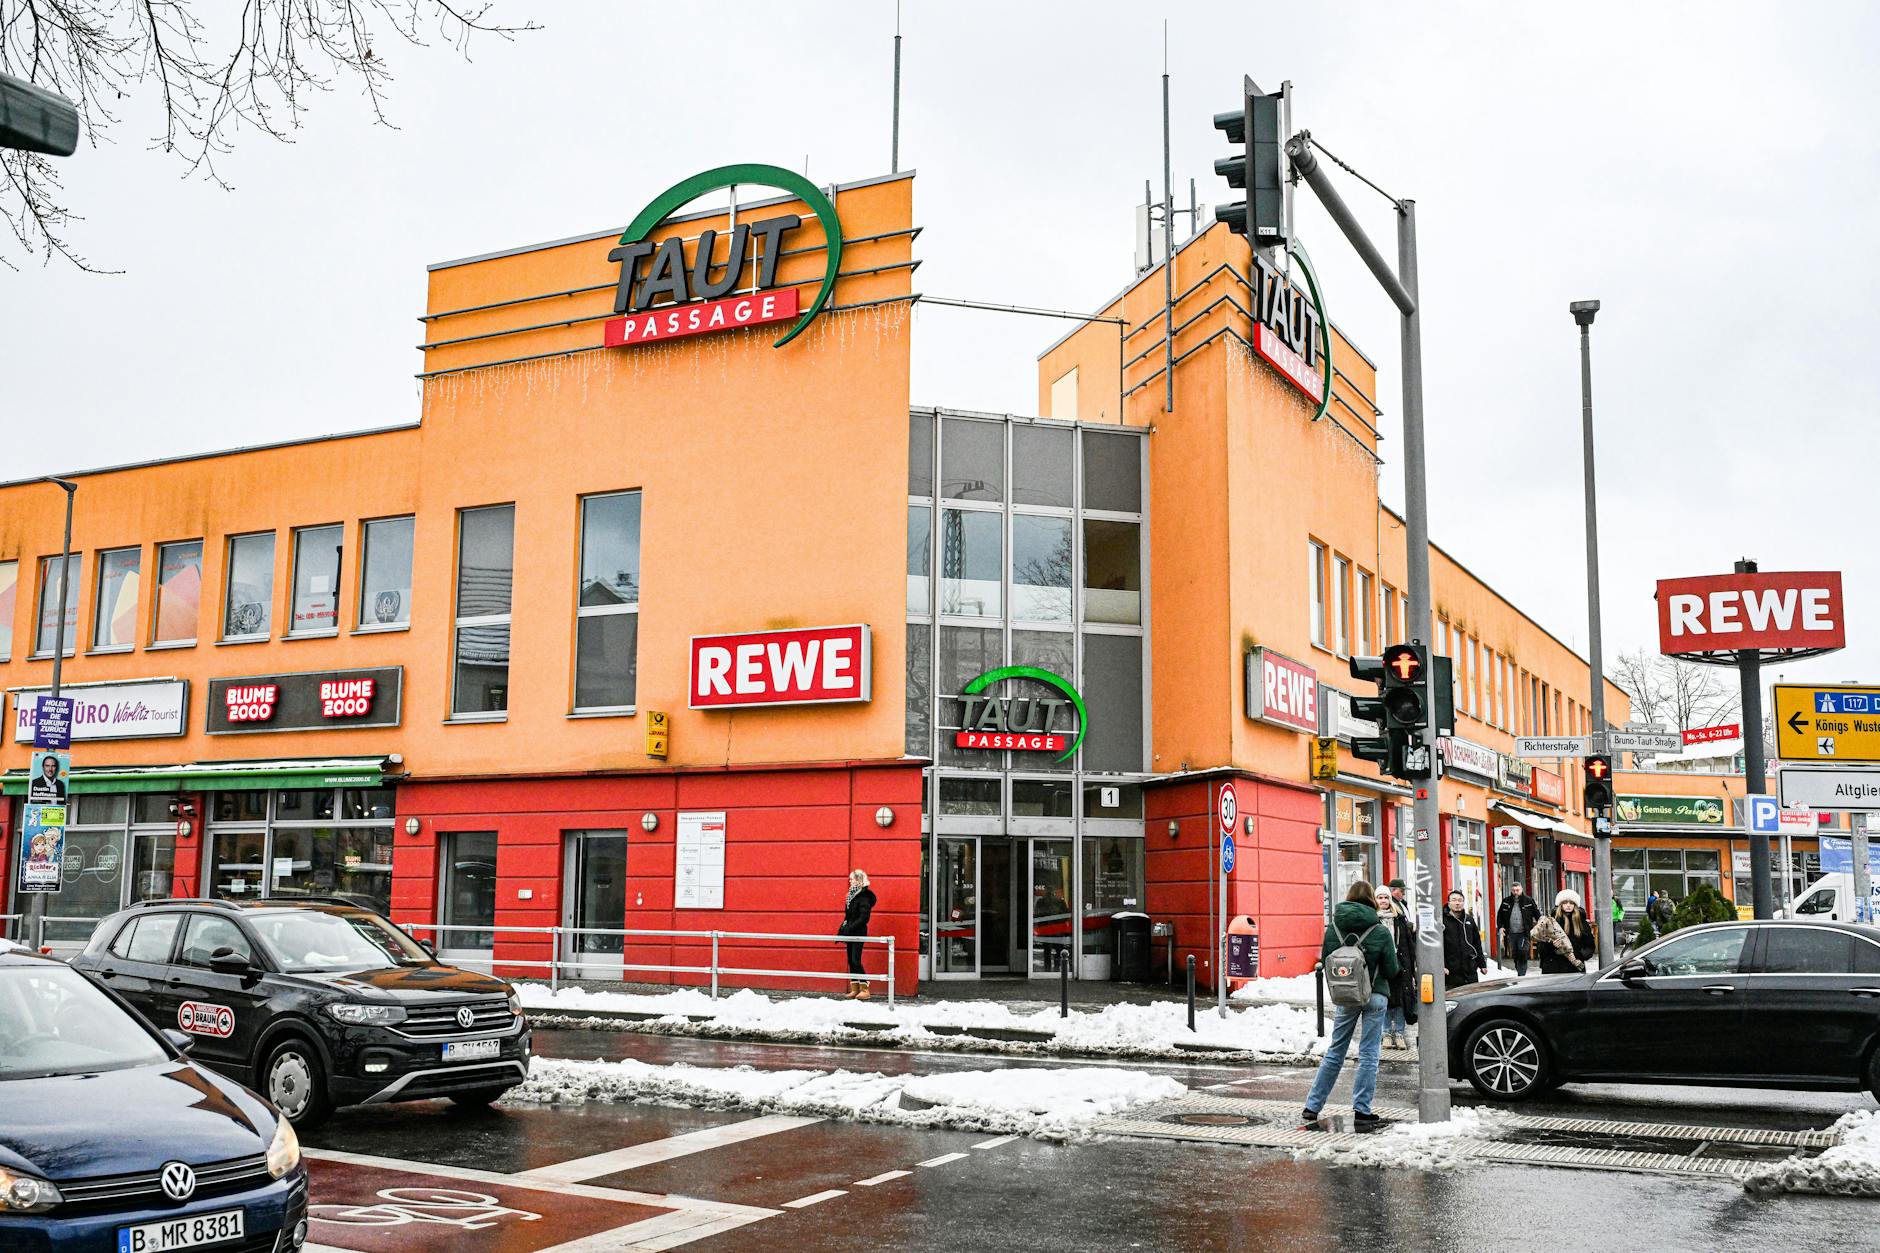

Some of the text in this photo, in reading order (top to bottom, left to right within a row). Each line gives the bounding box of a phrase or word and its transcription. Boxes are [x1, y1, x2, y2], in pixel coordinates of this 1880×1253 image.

[608, 214, 802, 313] TAUT
[623, 296, 776, 341] PASSAGE
[1254, 255, 1321, 368] TAUT
[1267, 334, 1319, 396] PASSAGE
[1669, 588, 1834, 637] REWE
[698, 637, 854, 696] REWE
[227, 686, 275, 705] BLUME
[320, 680, 372, 700] BLUME
[1264, 660, 1316, 723] REWE
[56, 707, 69, 715] UNS
[323, 699, 368, 716] 2000
[1848, 698, 1863, 708] 117
[112, 700, 151, 725] Wörlitz
[151, 709, 178, 721] Tourist
[229, 704, 271, 720] 2000
[957, 695, 1066, 733] TAUT
[39, 719, 69, 727] ZUKUNFT
[40, 725, 67, 733] ZURÜCK
[1816, 718, 1848, 735] Königs
[1614, 735, 1677, 748] Bruno-Taut-Straße
[1723, 729, 1733, 737] Uhr
[968, 735, 1054, 749] PASSAGE
[1524, 741, 1579, 752] Richterstraße
[1107, 790, 1113, 804] 1
[1835, 784, 1880, 799] Altglie
[1223, 798, 1234, 821] 30
[1643, 804, 1672, 814] Gemüse
[1756, 803, 1776, 828] P
[195, 1012, 216, 1024] BRAUN
[133, 1229, 146, 1252] B
[162, 1222, 188, 1247] MR
[193, 1214, 241, 1242] 8381
